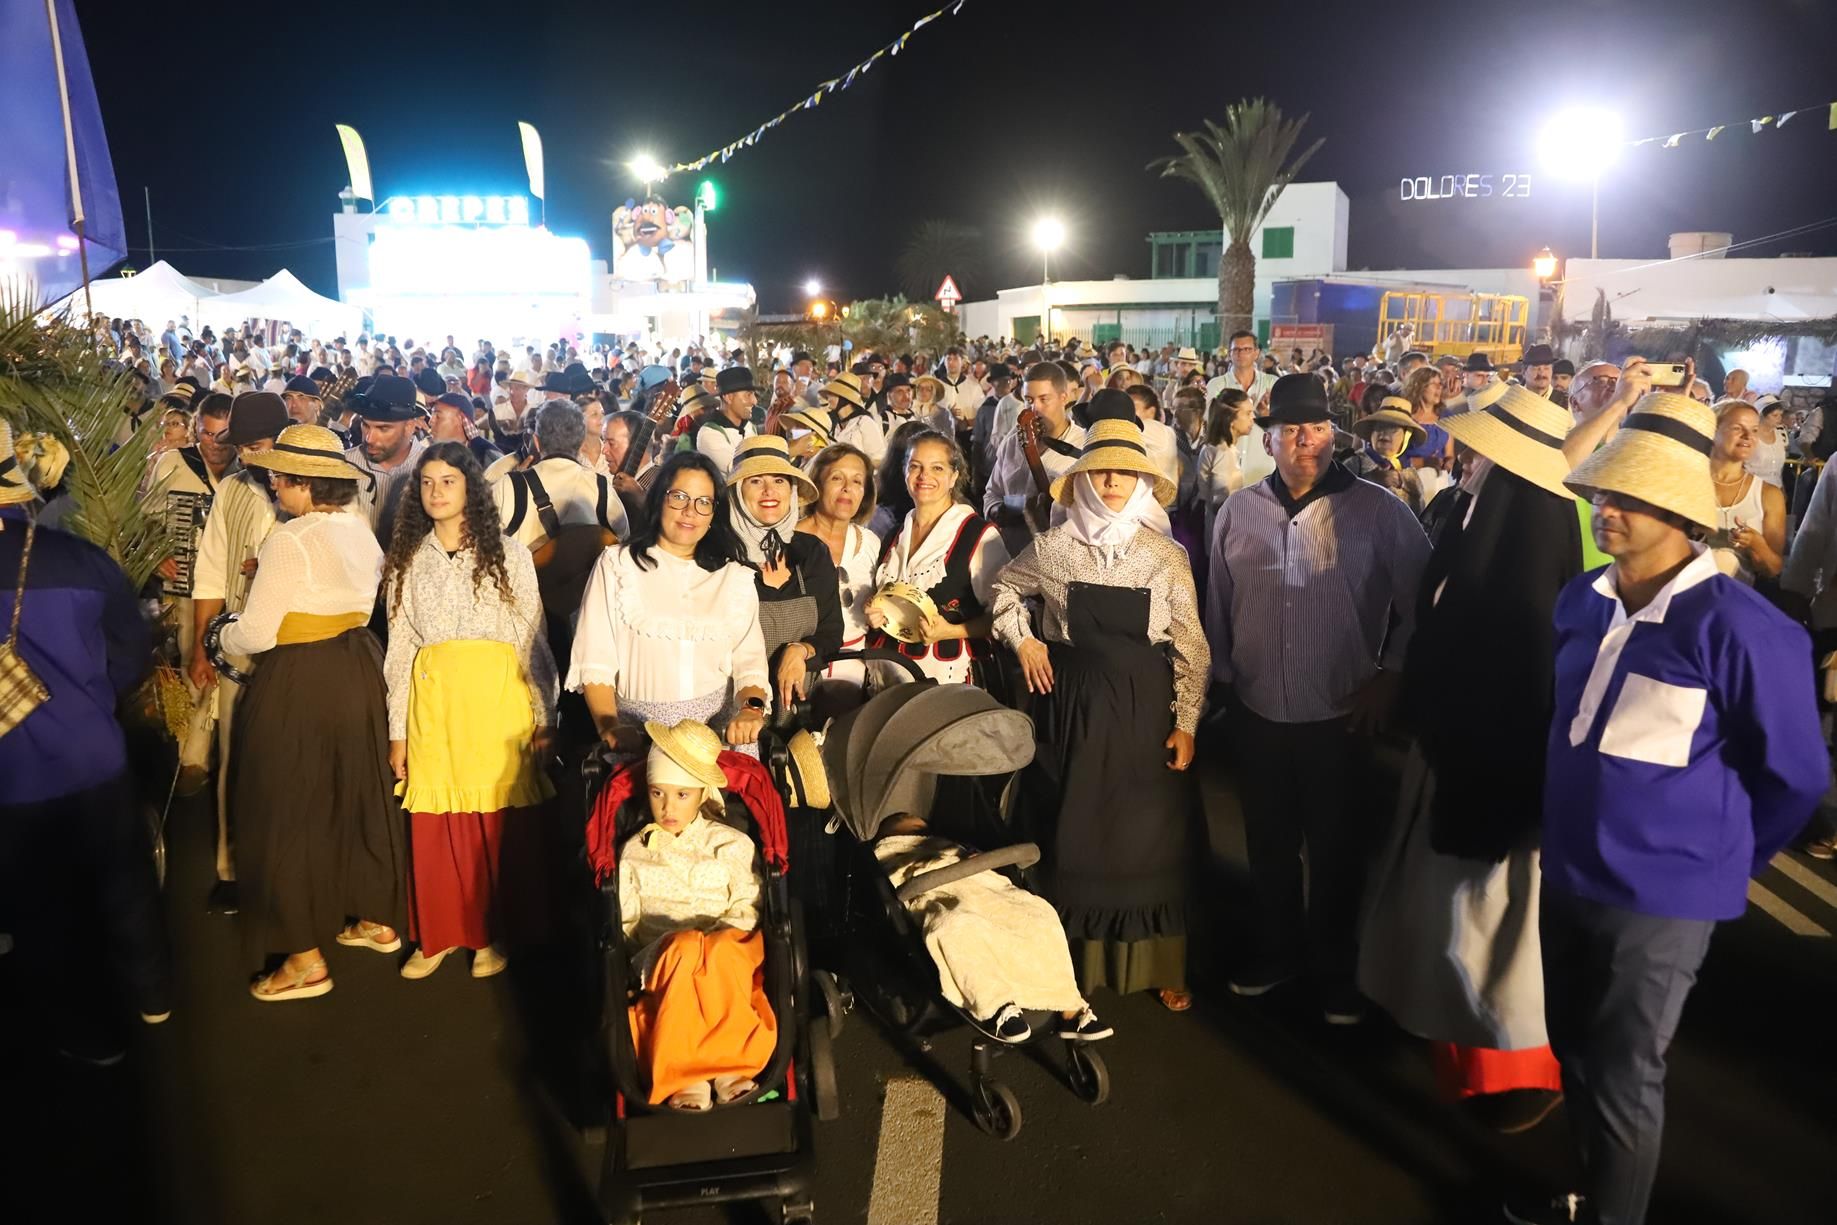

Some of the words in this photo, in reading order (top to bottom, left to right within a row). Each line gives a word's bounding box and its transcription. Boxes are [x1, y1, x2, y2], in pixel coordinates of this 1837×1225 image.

[1401, 174, 1493, 200] DOLORES
[1502, 174, 1531, 197] 23
[700, 1186, 720, 1196] PLAY
